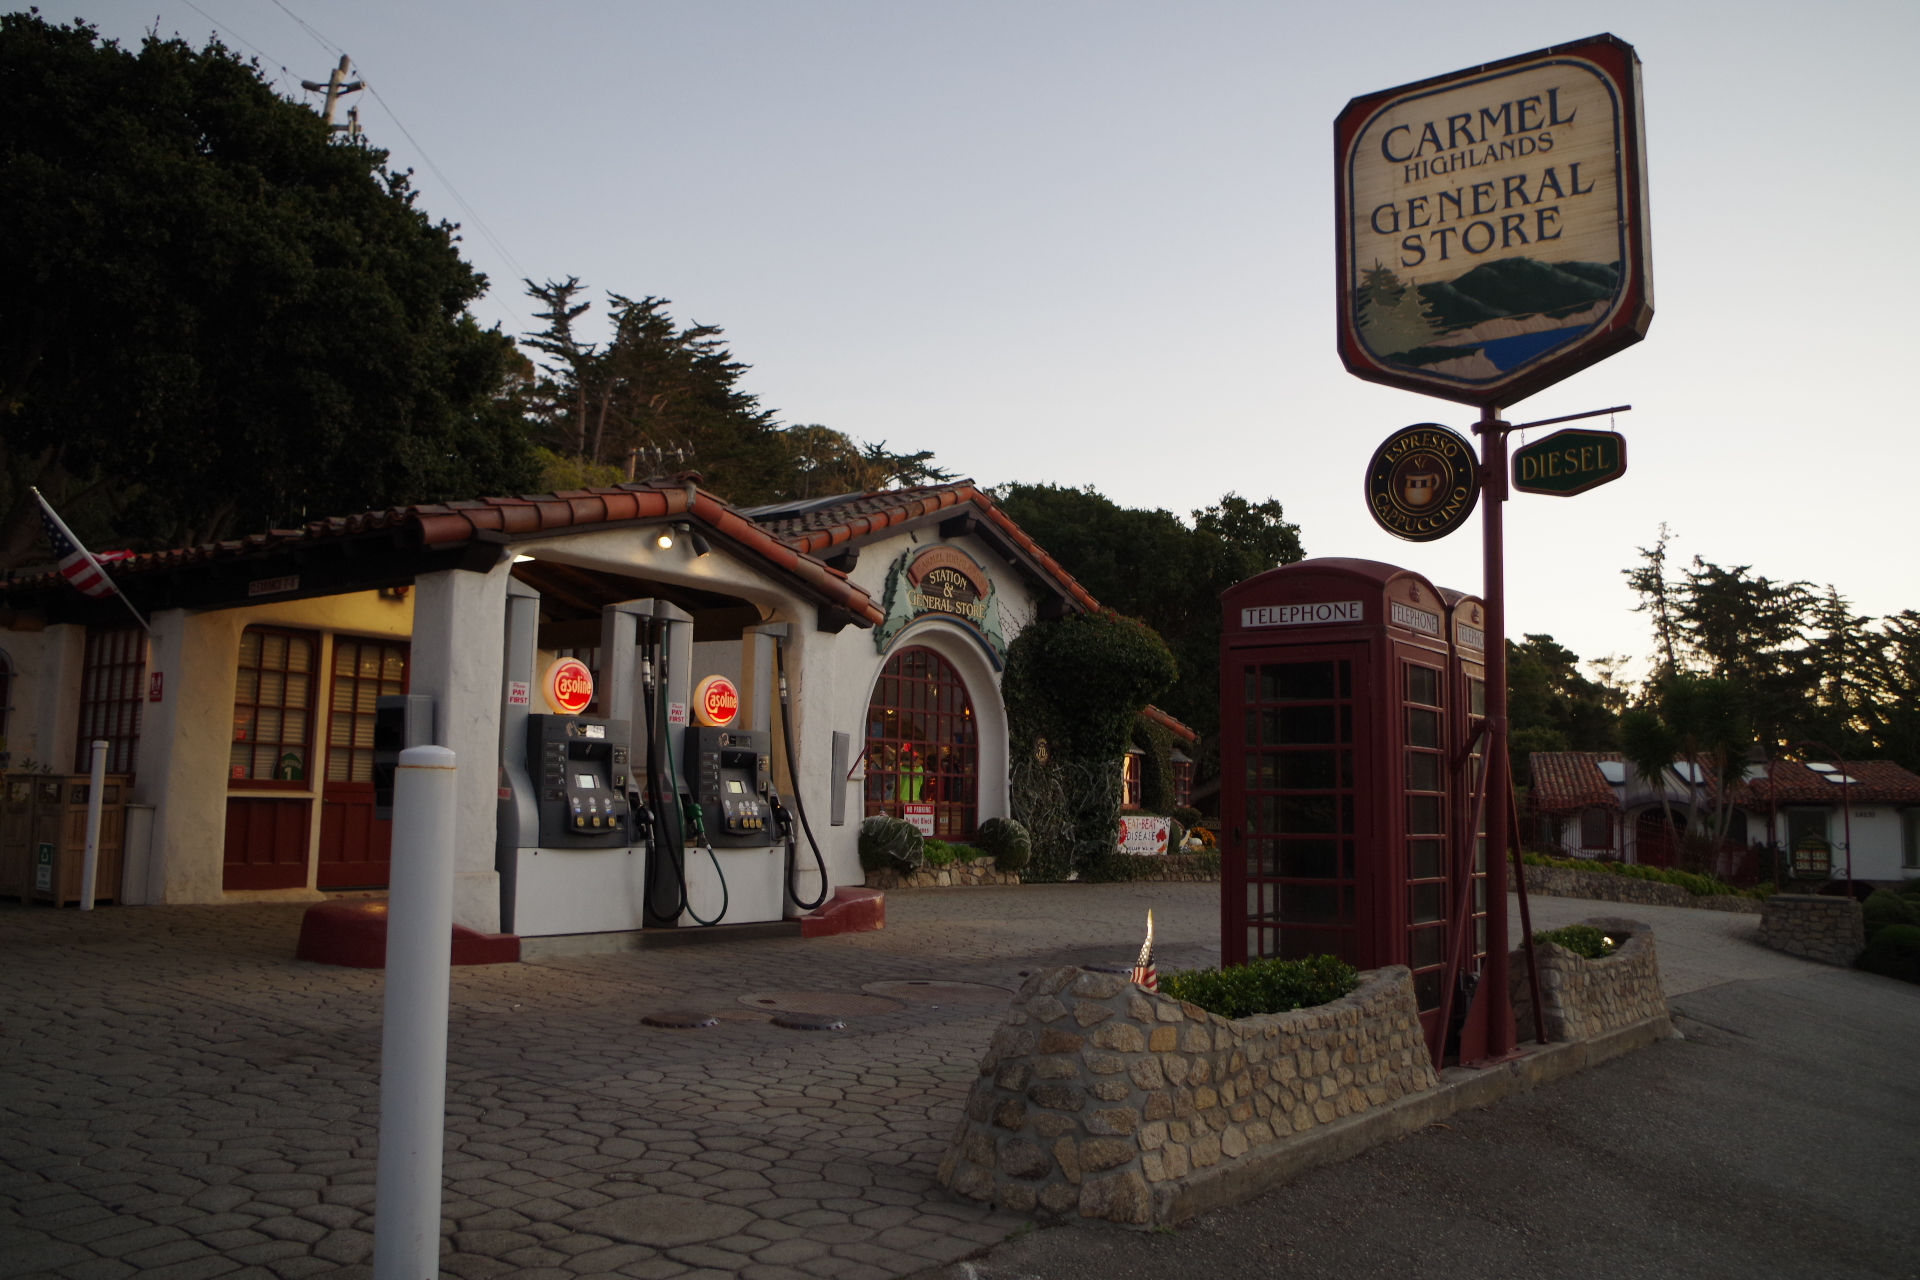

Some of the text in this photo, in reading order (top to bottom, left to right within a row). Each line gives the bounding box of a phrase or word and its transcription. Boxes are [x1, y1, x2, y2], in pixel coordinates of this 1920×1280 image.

[1381, 86, 1578, 164] CARMEL
[1403, 132, 1554, 184] HIGHLANDS
[1370, 162, 1596, 235] GENERAL
[1400, 206, 1564, 268] STORE
[1385, 432, 1458, 464] ESPRESSO
[1522, 444, 1610, 481] DIESEL
[1375, 485, 1468, 532] CAPPUCCINO
[929, 569, 967, 591] STATION
[943, 582, 953, 598] &
[908, 590, 986, 619] GENERAL STORE
[1246, 603, 1359, 625] TELEPHONE
[1392, 604, 1438, 633] TELEPHONE
[555, 672, 592, 700] Gasoline
[706, 688, 737, 713] Gasoline
[1127, 831, 1156, 841] DISEASE
